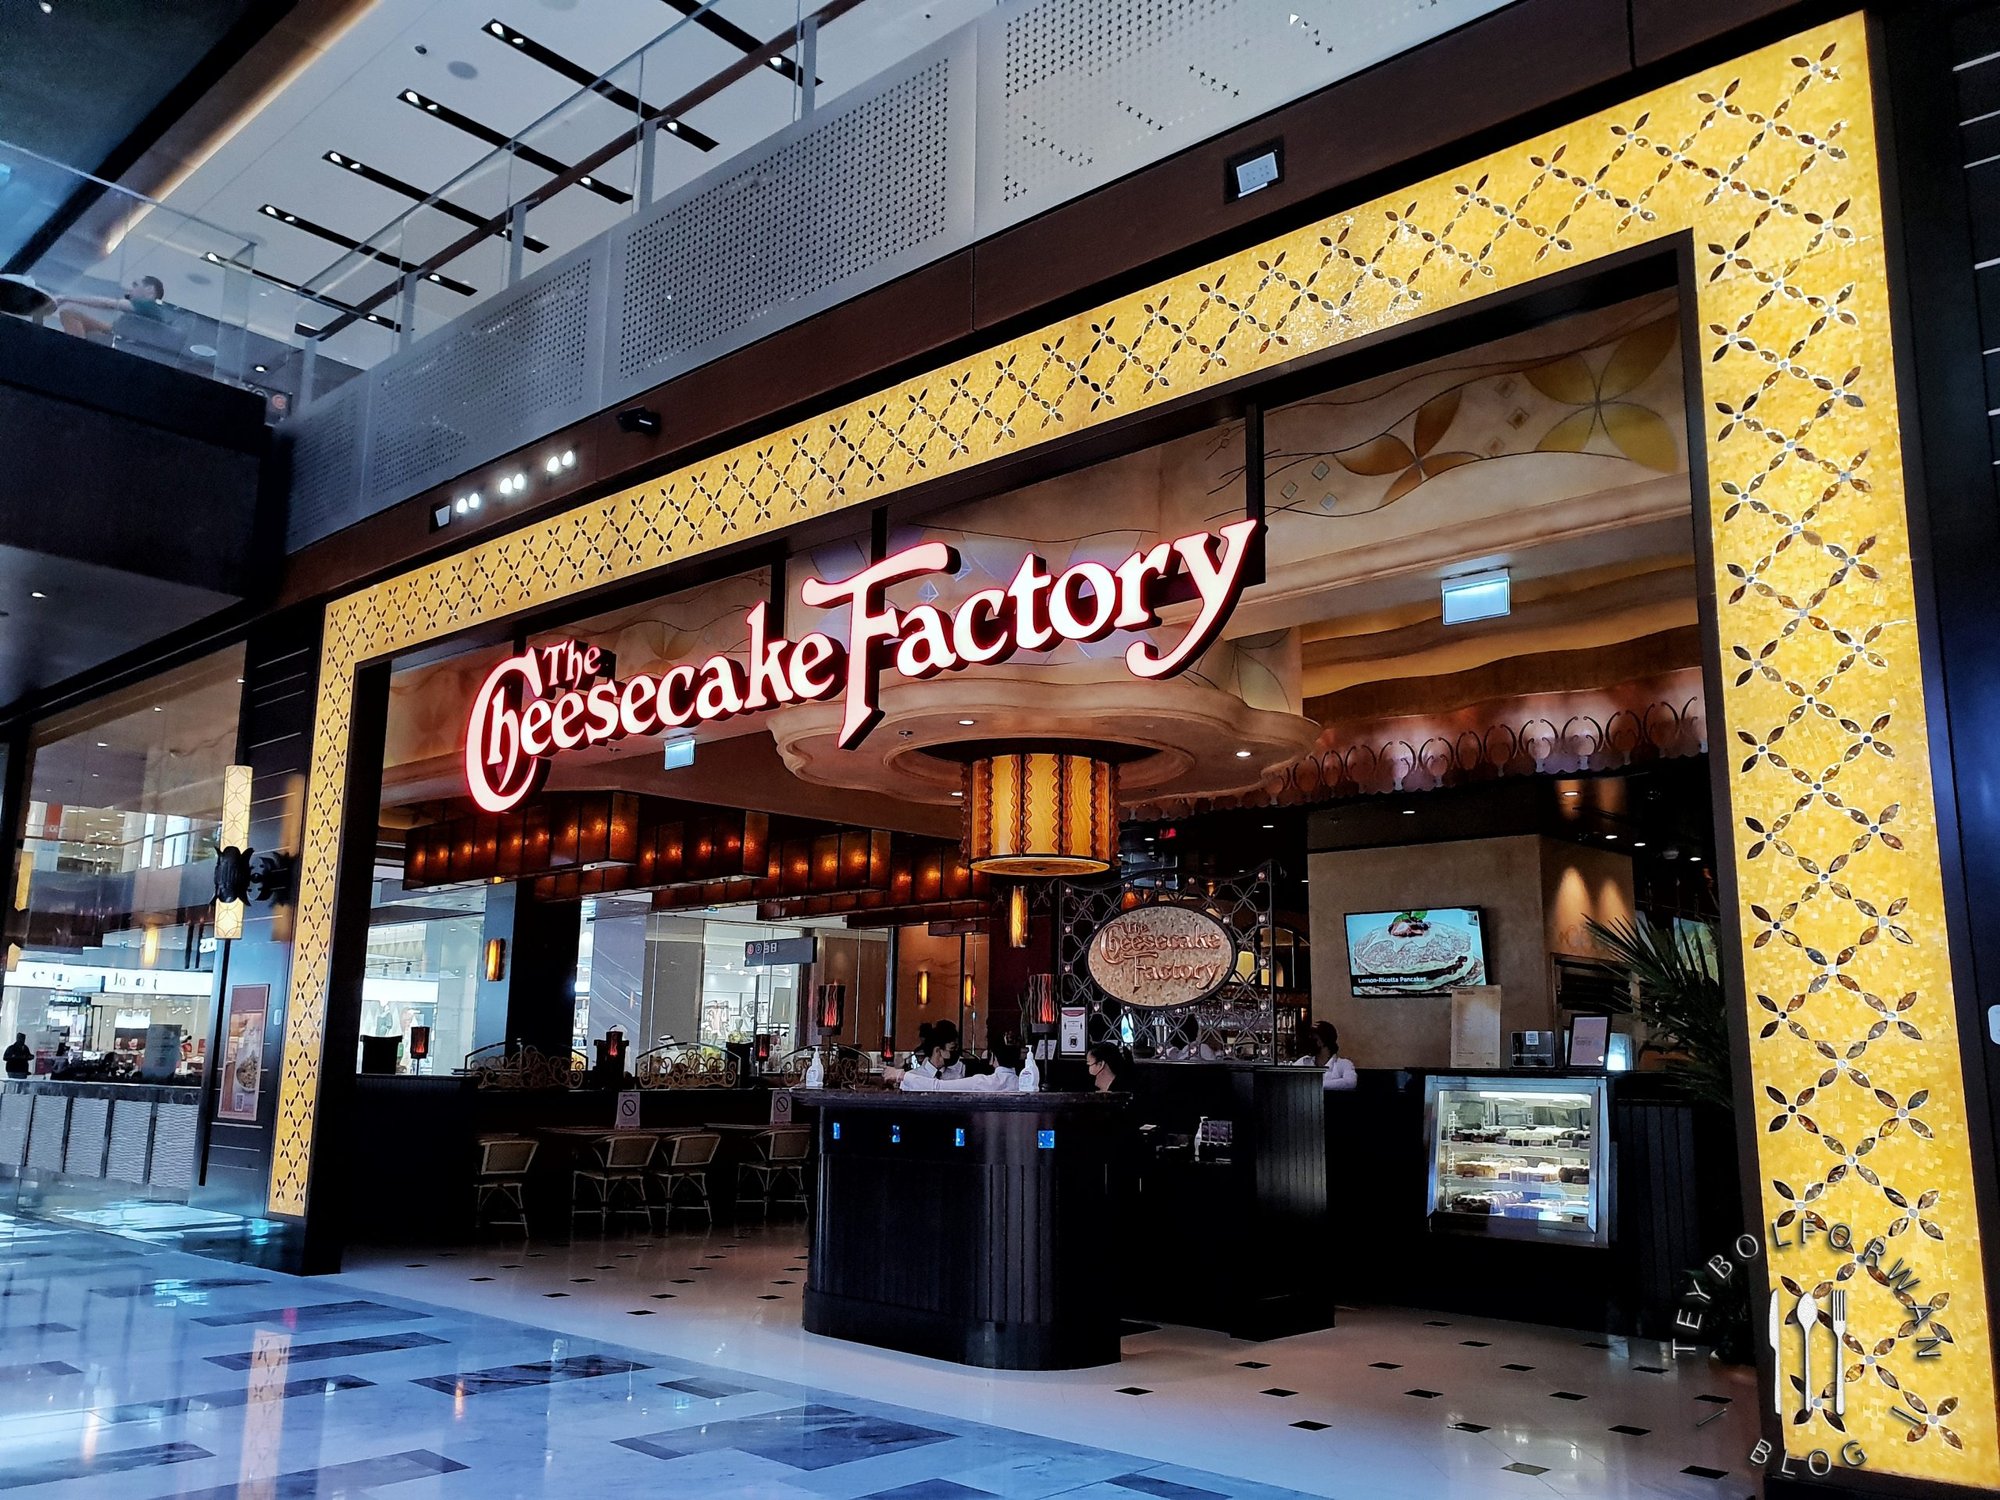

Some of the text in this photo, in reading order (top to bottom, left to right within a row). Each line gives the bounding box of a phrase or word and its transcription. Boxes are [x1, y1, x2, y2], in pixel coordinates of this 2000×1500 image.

[465, 518, 1258, 813] Cheesecake Factory
[541, 638, 602, 688] The
[1100, 922, 1221, 965] Cheesecake
[1122, 951, 1221, 994] Factory
